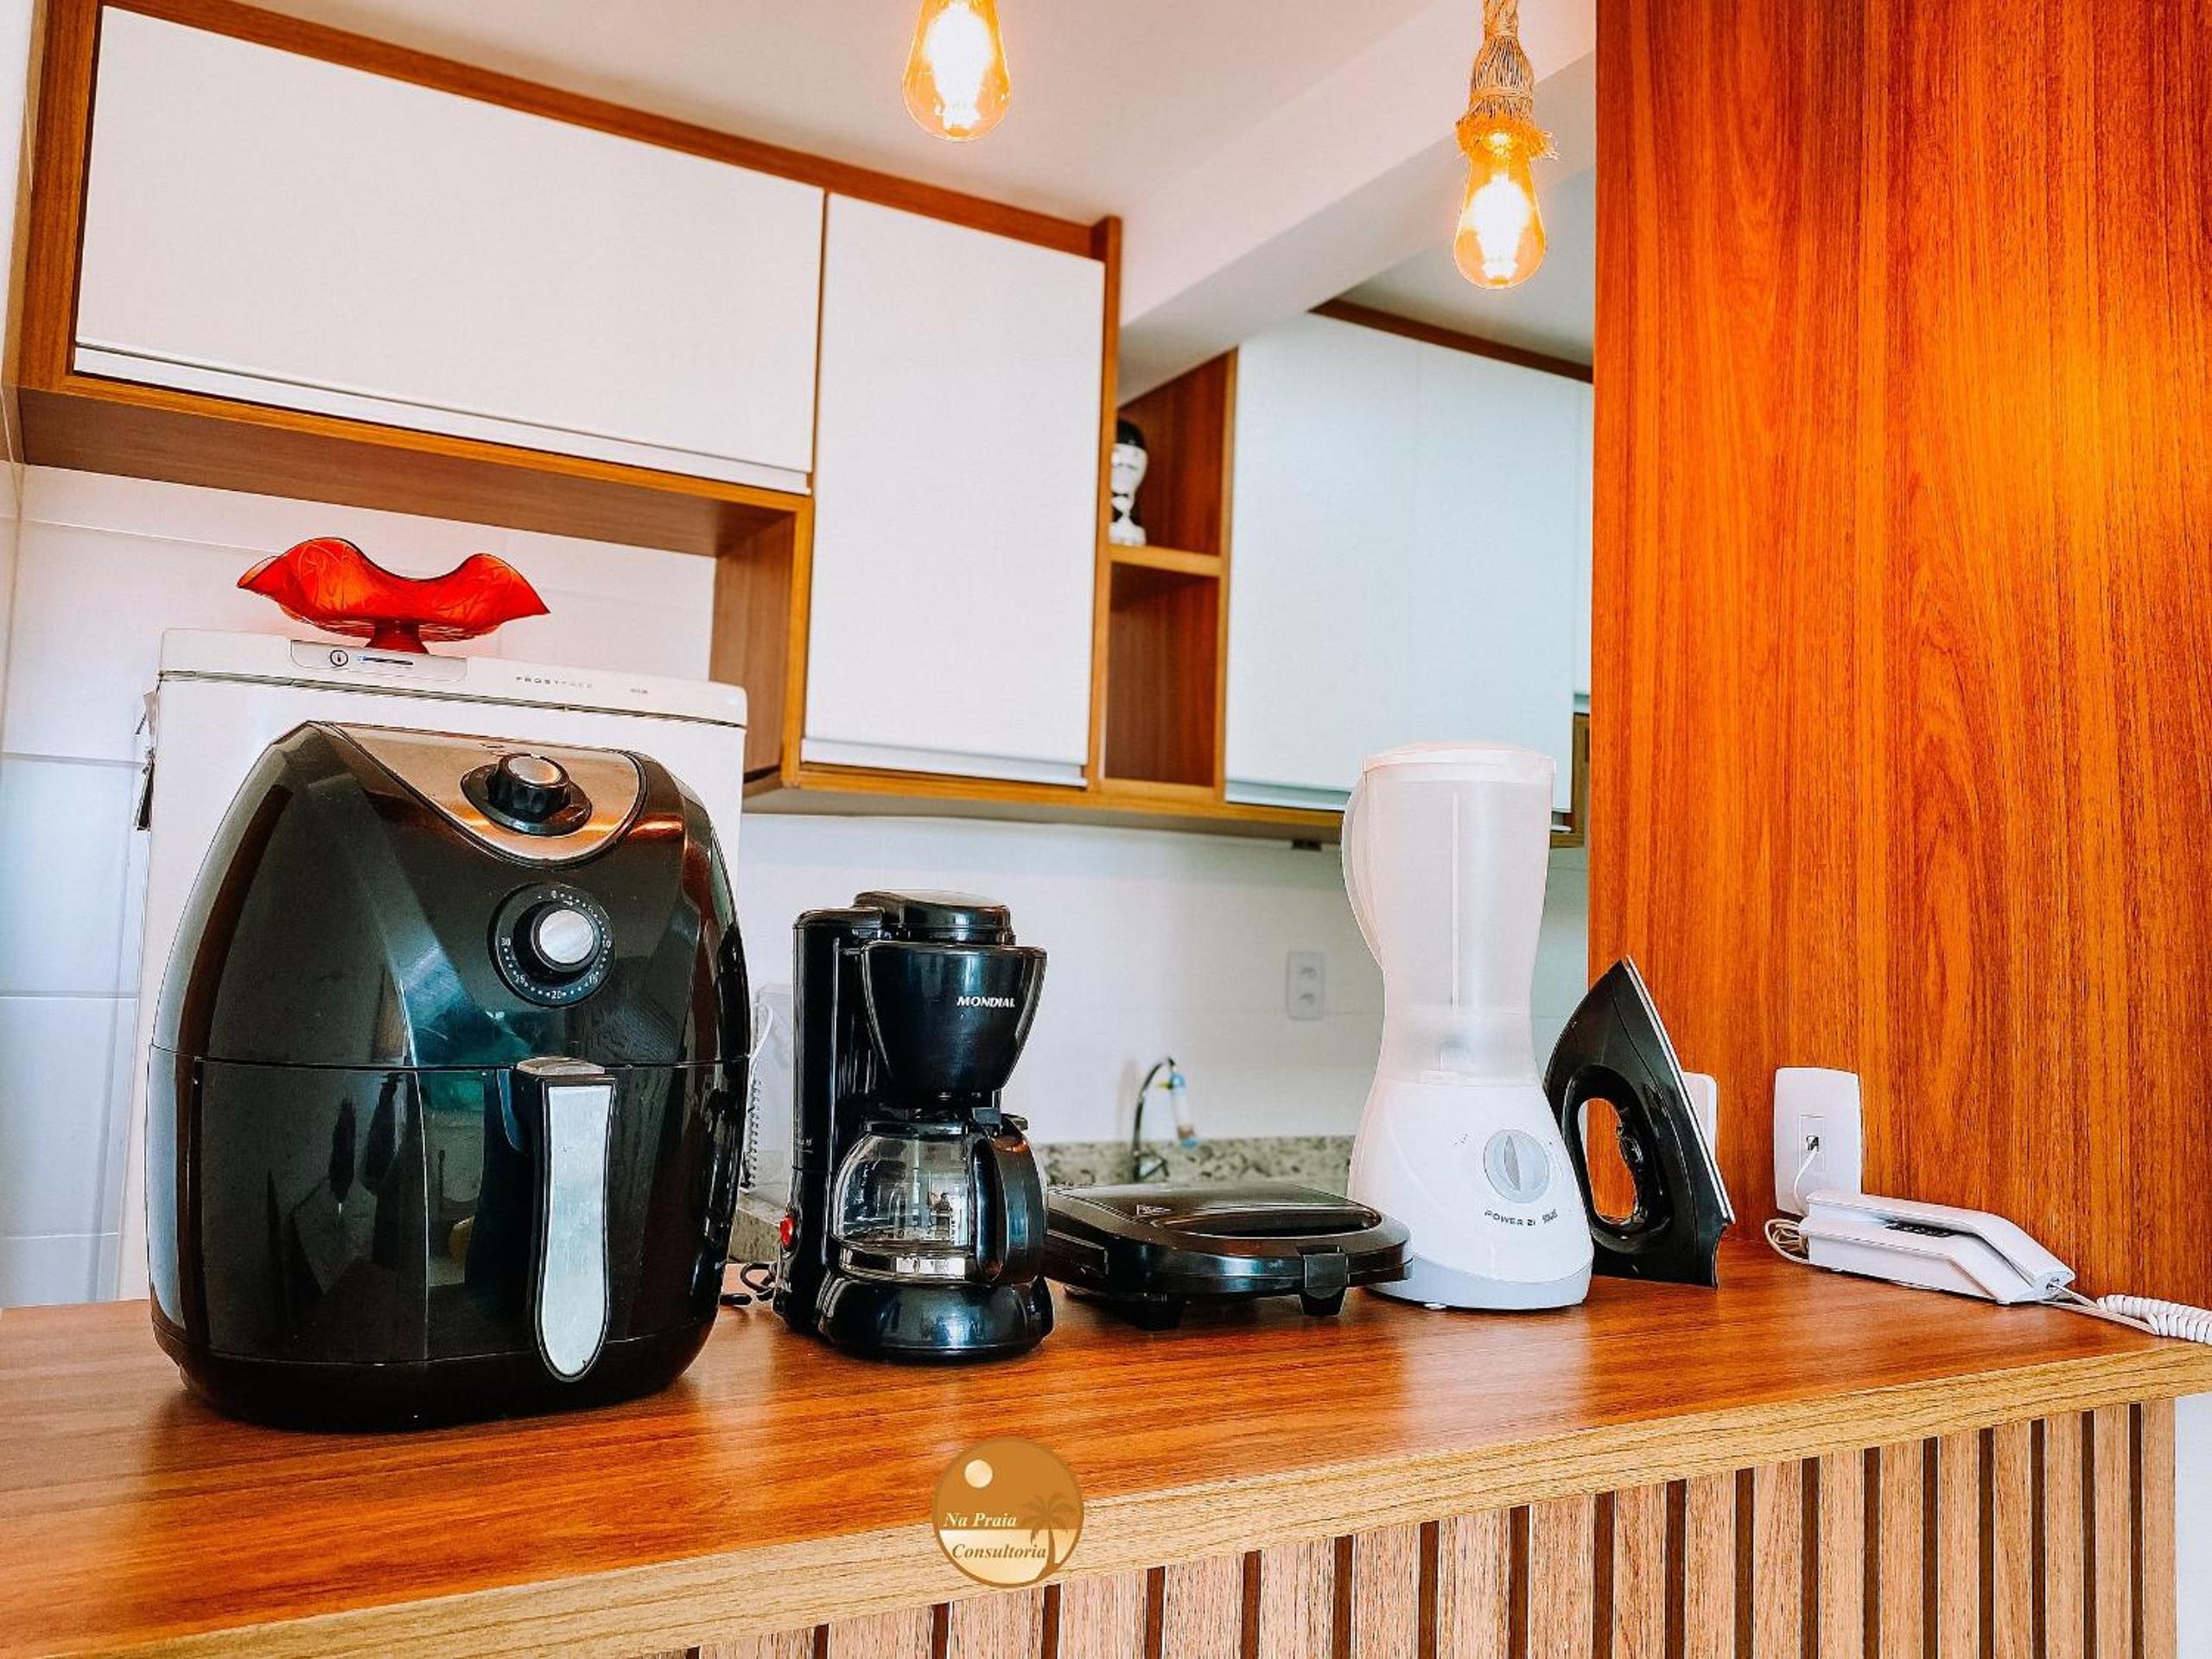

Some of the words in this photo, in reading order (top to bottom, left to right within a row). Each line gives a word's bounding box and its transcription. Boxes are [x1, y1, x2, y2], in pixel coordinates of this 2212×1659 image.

[500, 938, 512, 946] 30
[550, 990, 563, 999] 20
[957, 996, 1015, 1007] MONDIAL
[1484, 1210, 1523, 1225] POWER
